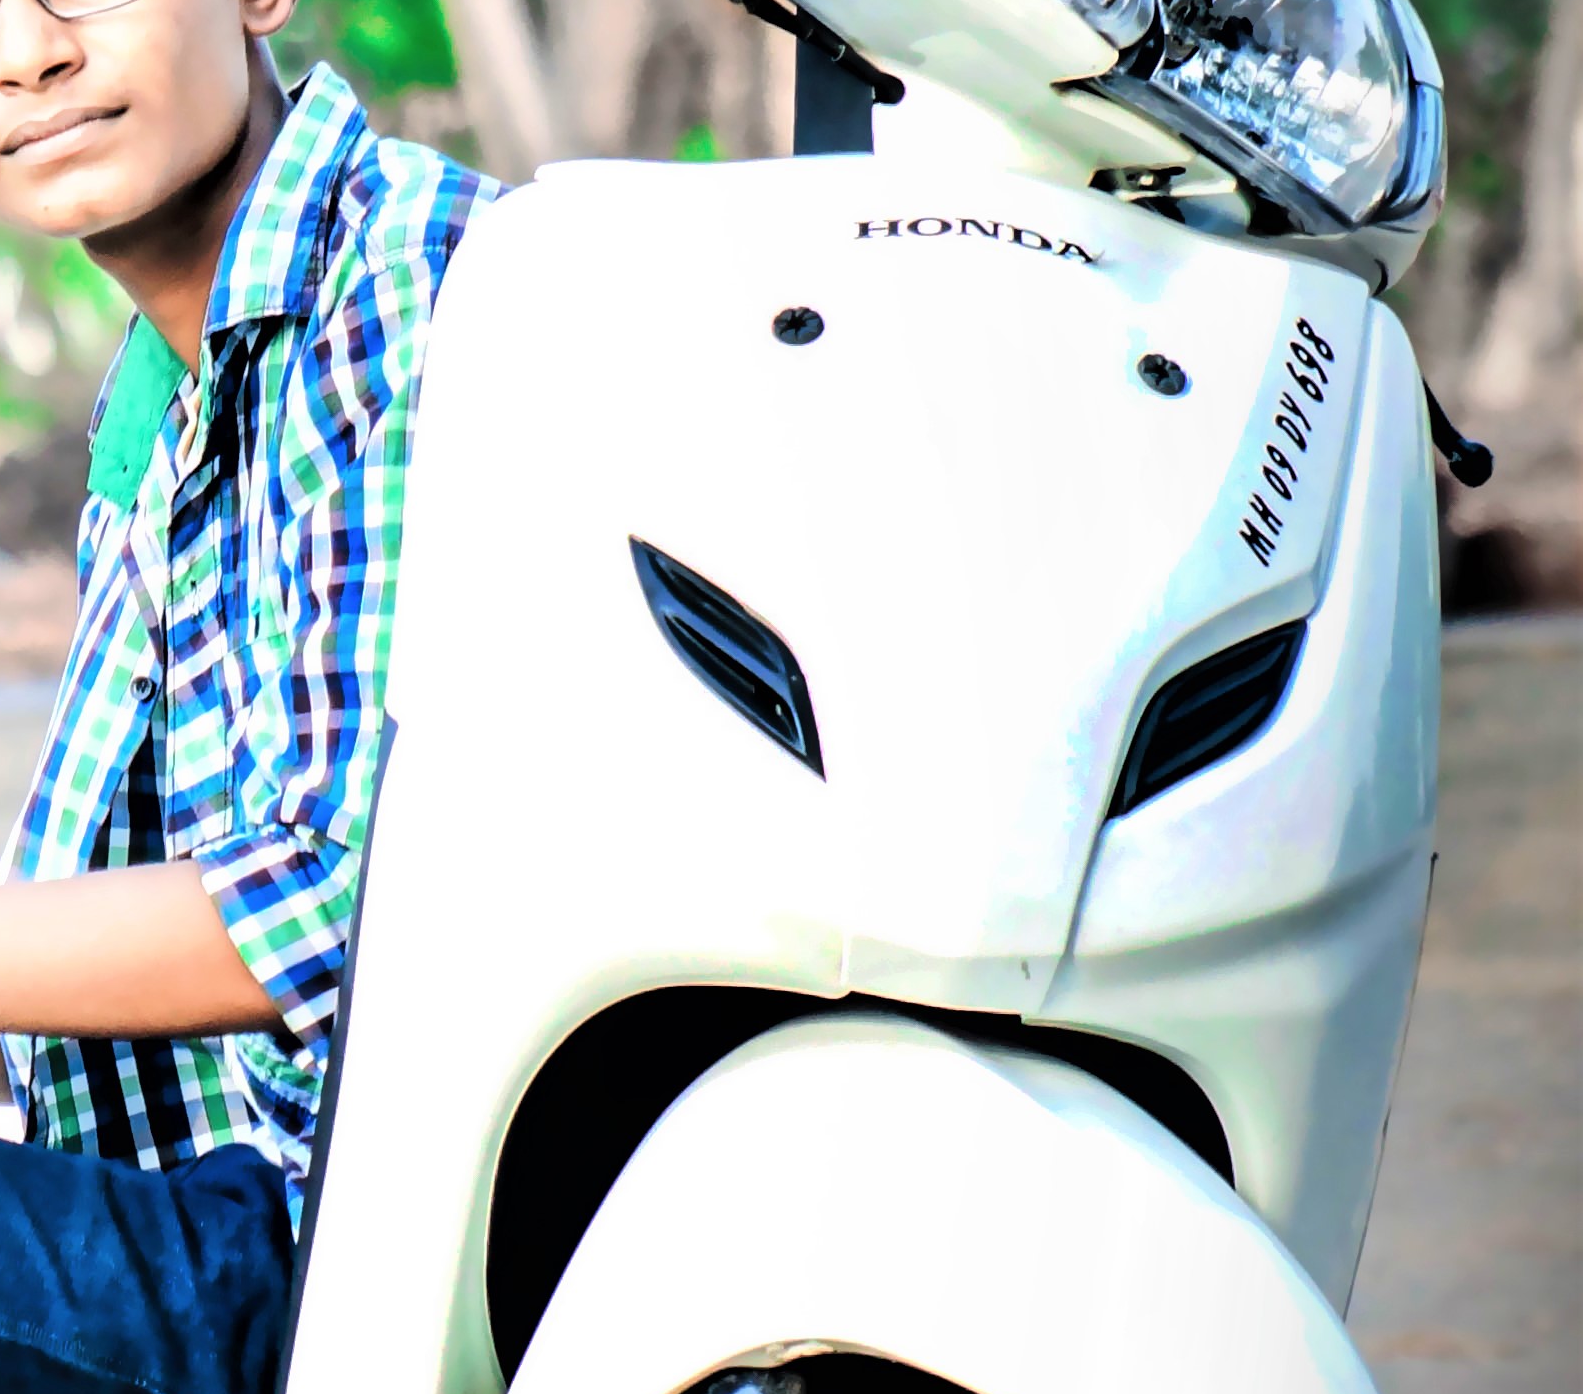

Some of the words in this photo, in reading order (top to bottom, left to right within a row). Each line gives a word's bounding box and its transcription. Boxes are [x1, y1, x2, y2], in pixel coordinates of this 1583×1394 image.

[854, 217, 1105, 265] HONDA
[1286, 317, 1335, 403] 698
[1275, 392, 1312, 452] DY
[1263, 444, 1298, 501] 09
[1239, 493, 1284, 567] MH
